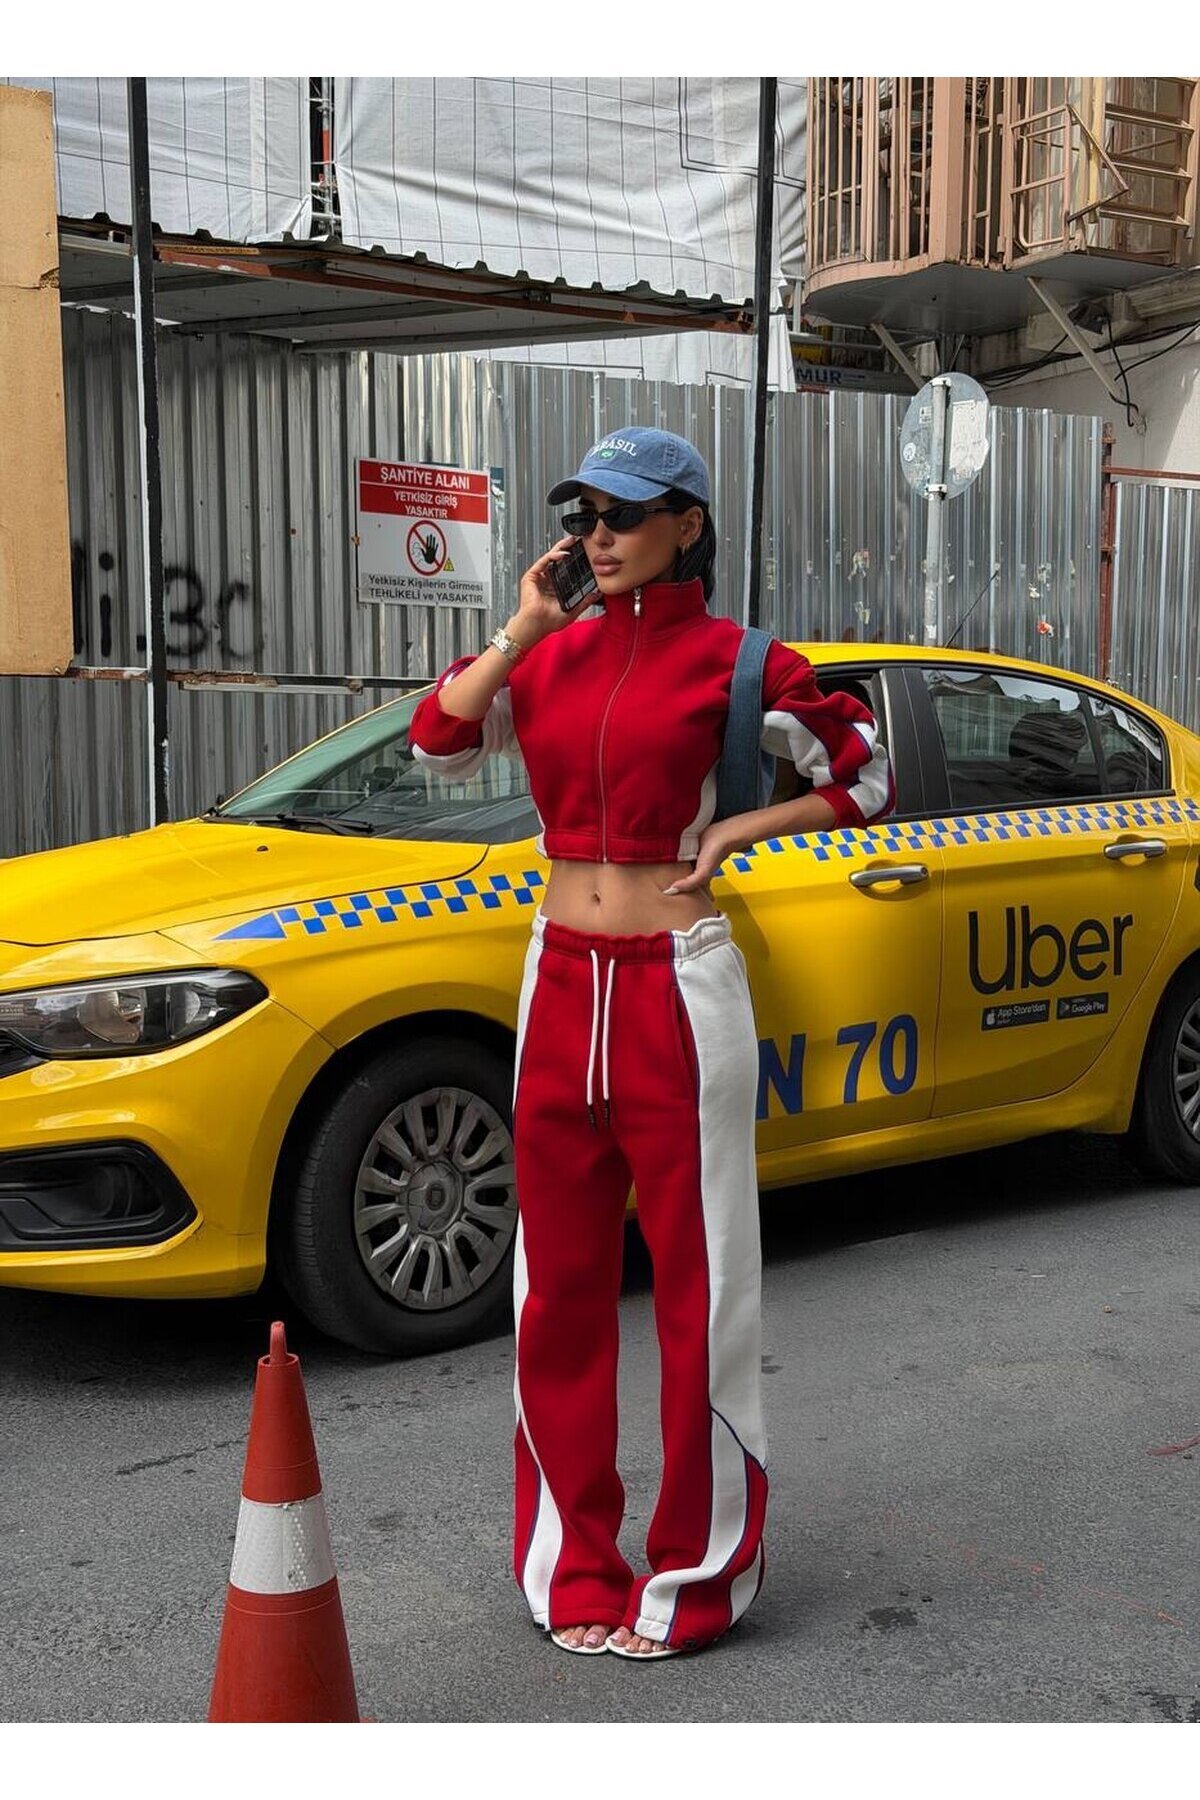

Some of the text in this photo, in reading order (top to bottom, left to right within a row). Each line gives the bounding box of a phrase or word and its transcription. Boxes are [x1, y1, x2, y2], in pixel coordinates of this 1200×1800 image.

[380, 466, 470, 490] ŞANTİYE ALANI
[394, 490, 458, 509] YETKİSİZ GİRİŞ
[405, 505, 448, 519] YASAKTIR
[369, 574, 483, 591] Yetkisiz Kişilerin Girmesi
[369, 587, 483, 603] TEHLİKELİ ve YASAKTIR
[968, 905, 1133, 995] Uber
[998, 1008, 1012, 1018] App
[1071, 1003, 1092, 1014] Google
[837, 1014, 918, 1104] 70
